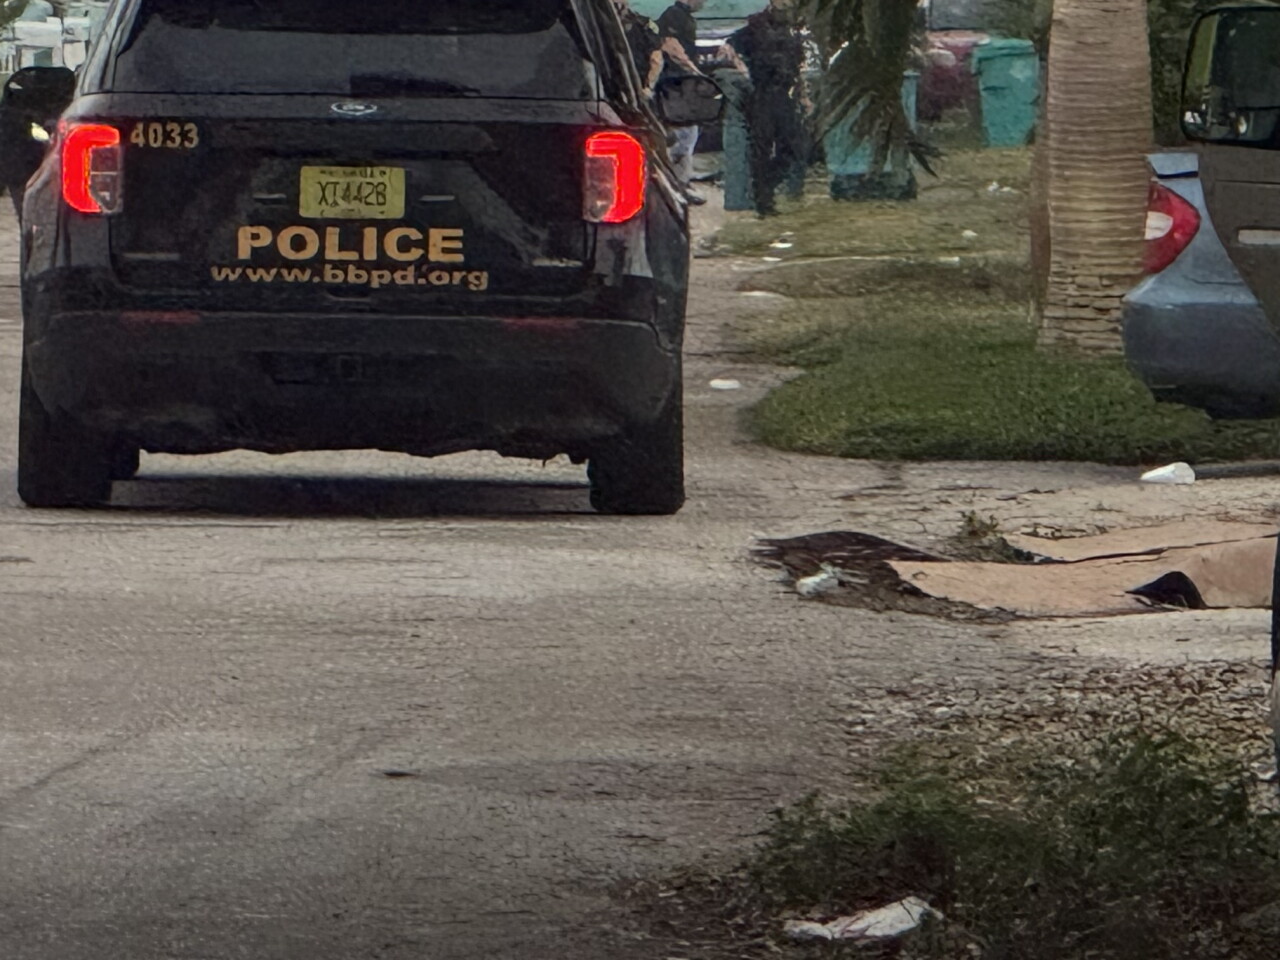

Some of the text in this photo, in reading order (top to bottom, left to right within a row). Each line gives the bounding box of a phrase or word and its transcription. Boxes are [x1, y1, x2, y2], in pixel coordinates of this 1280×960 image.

[130, 122, 200, 149] 4033
[236, 225, 465, 262] POLICE
[210, 263, 489, 291] www.bbpd.org
